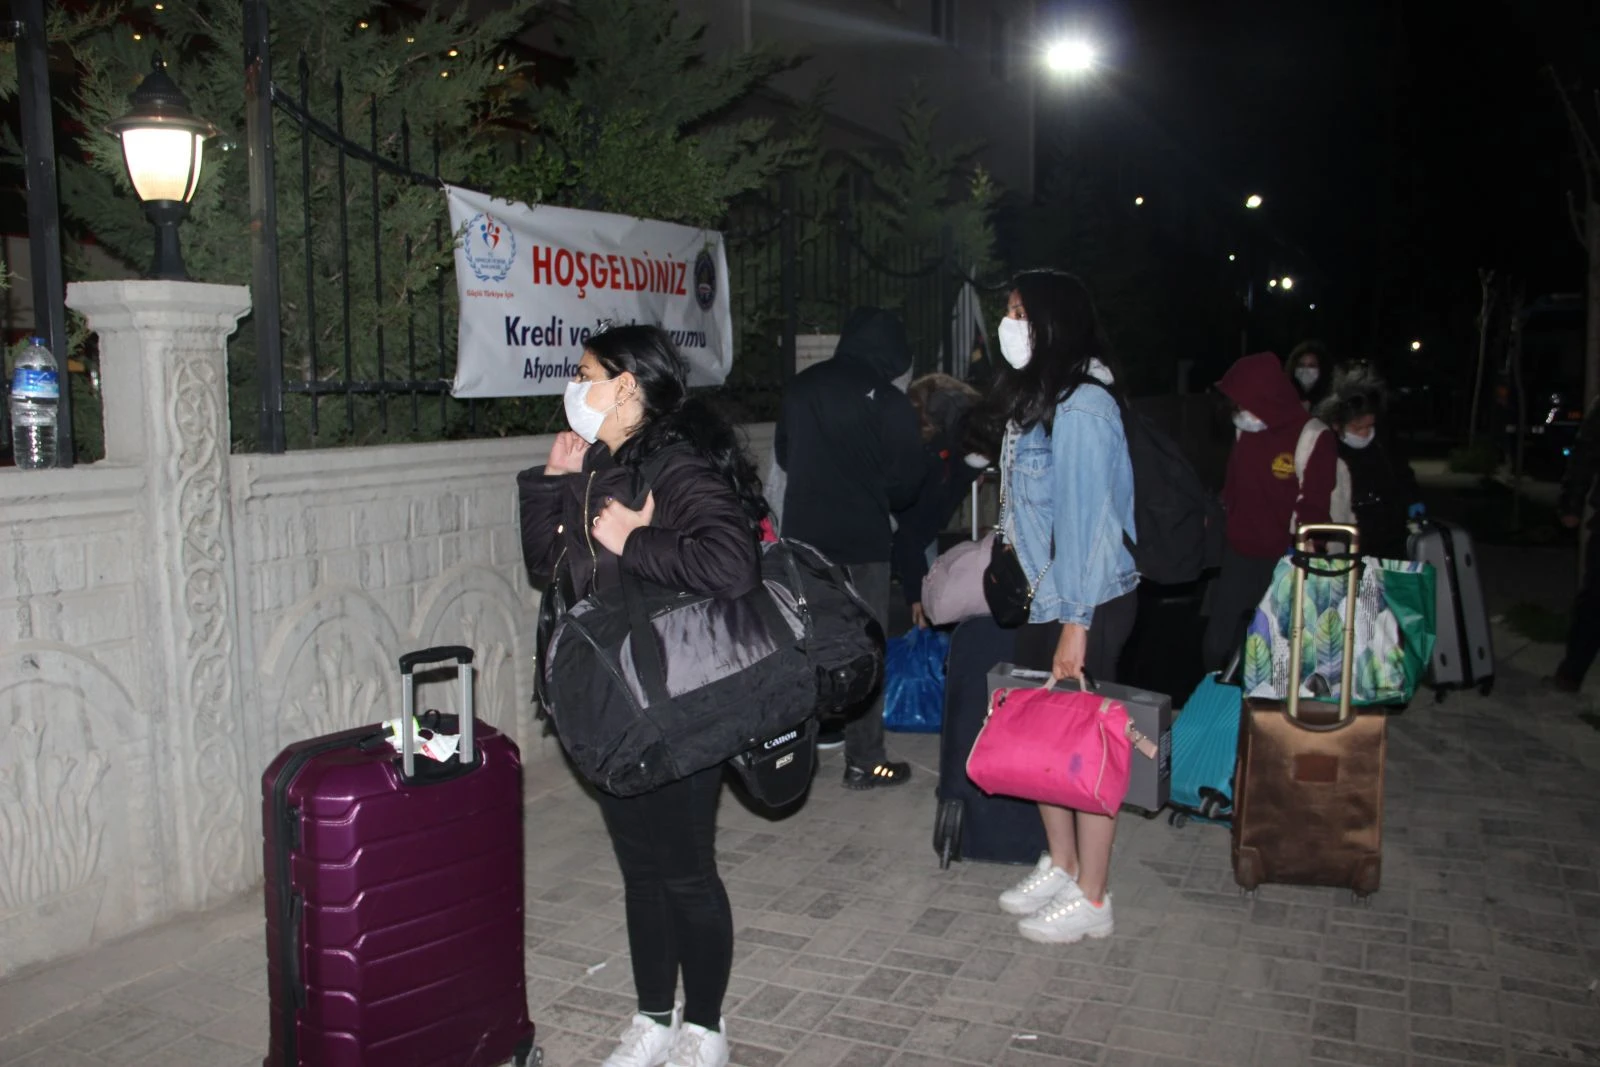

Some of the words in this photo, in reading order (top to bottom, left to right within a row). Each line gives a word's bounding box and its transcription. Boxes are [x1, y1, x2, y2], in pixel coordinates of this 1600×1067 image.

[533, 246, 686, 299] HOŞGELDİNİZ
[505, 316, 563, 347] Kredi
[571, 326, 590, 347] ve
[523, 357, 578, 383] Afyonka
[764, 731, 797, 749] Canon
